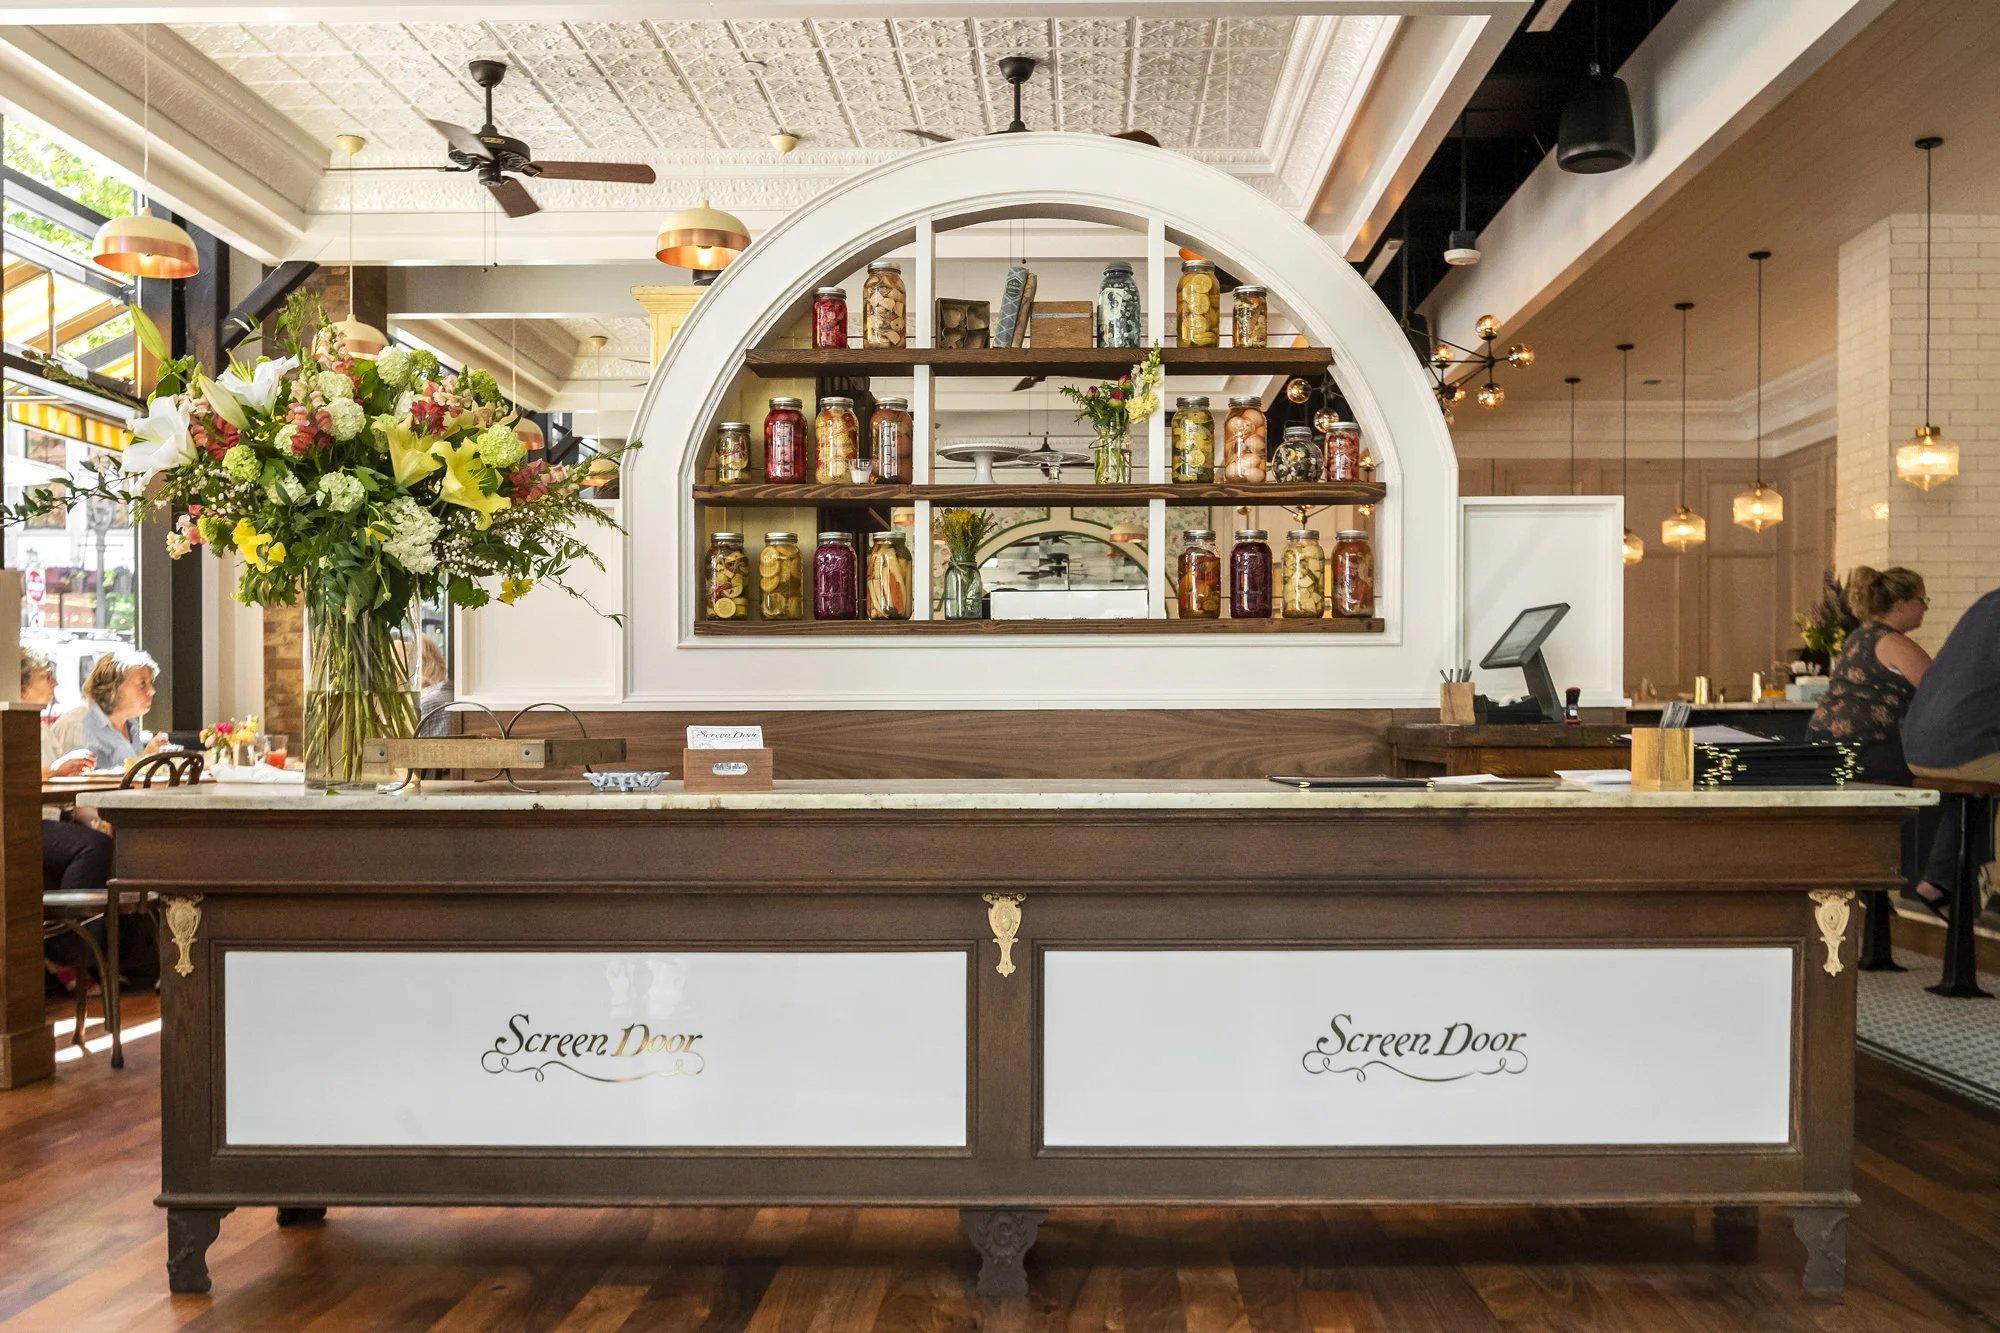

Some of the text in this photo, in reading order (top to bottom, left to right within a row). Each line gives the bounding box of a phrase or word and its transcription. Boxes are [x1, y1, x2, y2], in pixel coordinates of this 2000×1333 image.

[494, 1013, 703, 1058] Screen Door
[1316, 1013, 1527, 1058] Screen Door
